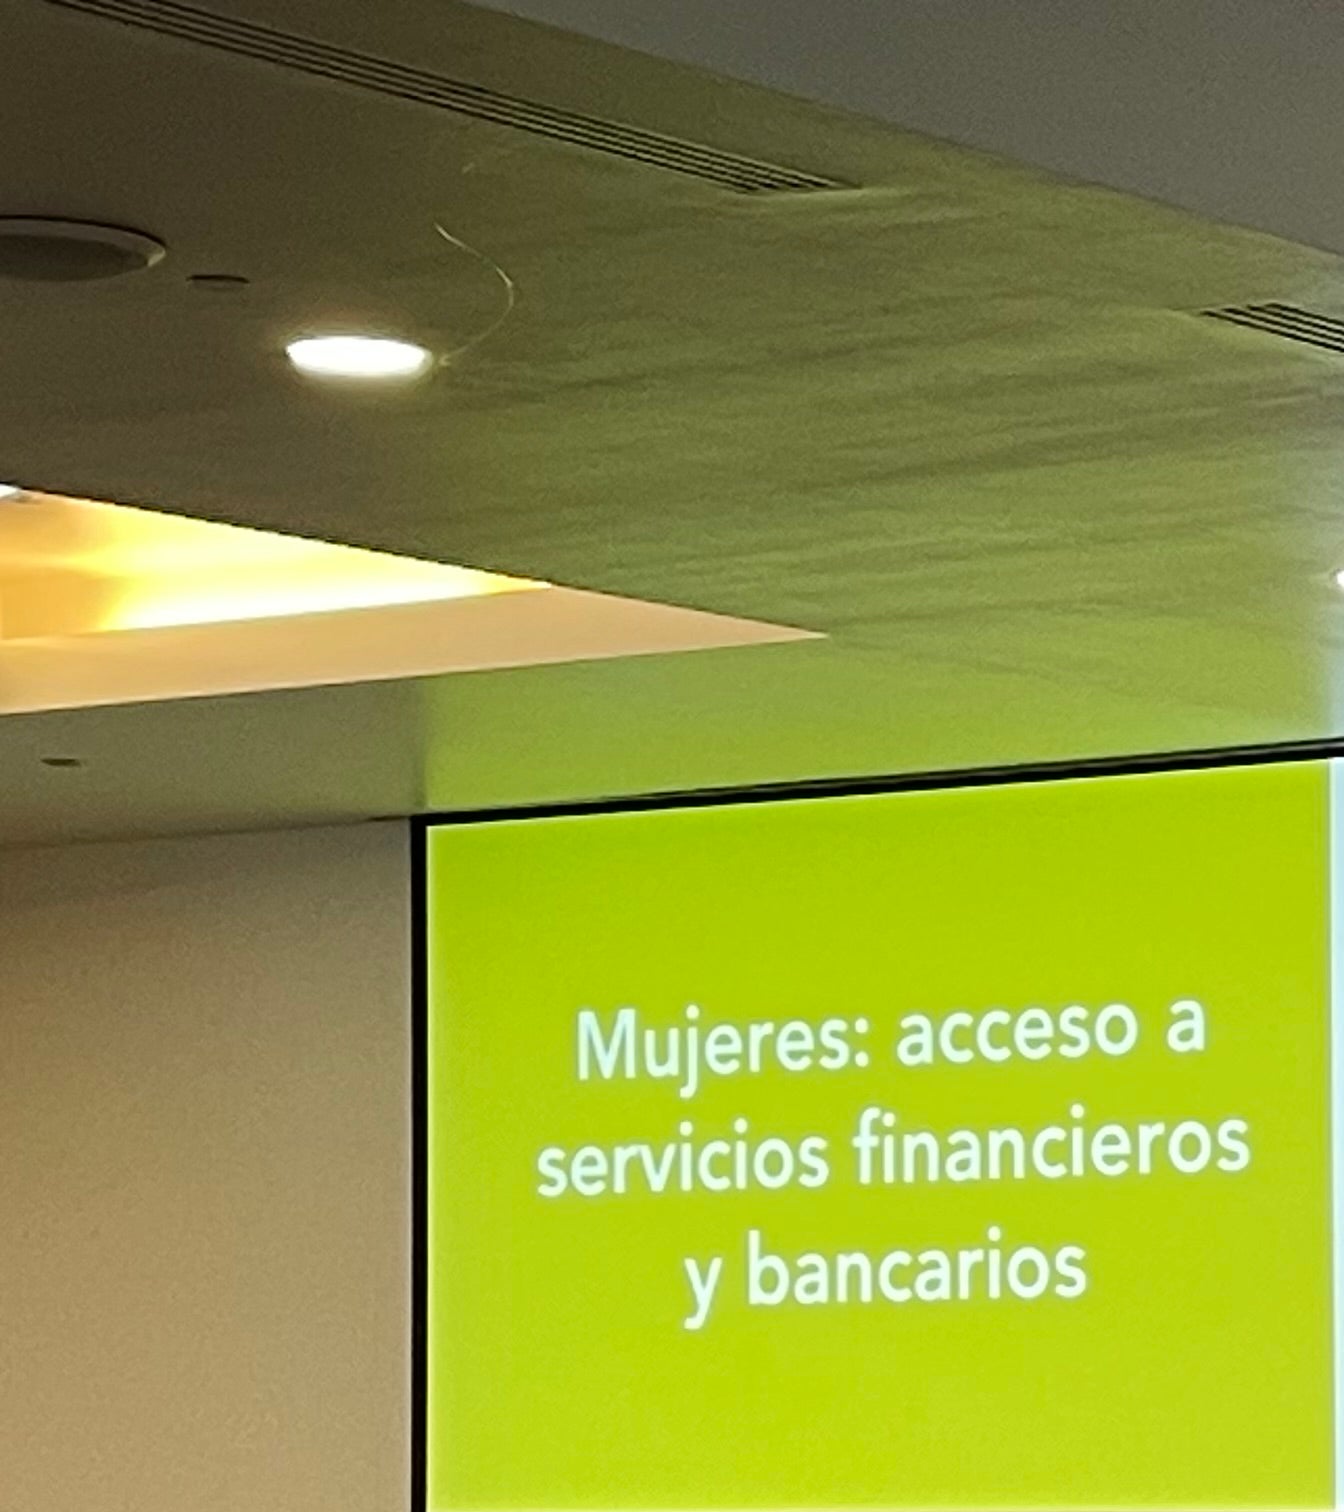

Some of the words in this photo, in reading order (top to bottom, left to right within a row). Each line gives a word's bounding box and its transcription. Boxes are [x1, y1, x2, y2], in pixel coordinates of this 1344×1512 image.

[576, 1003, 871, 1099] Mujeres:
[895, 1001, 1140, 1068] acceso
[1165, 998, 1207, 1053] a
[535, 1116, 831, 1199] servicios
[850, 1102, 1253, 1186] financieros
[682, 1255, 724, 1332] y
[746, 1224, 1089, 1307] bancarios
